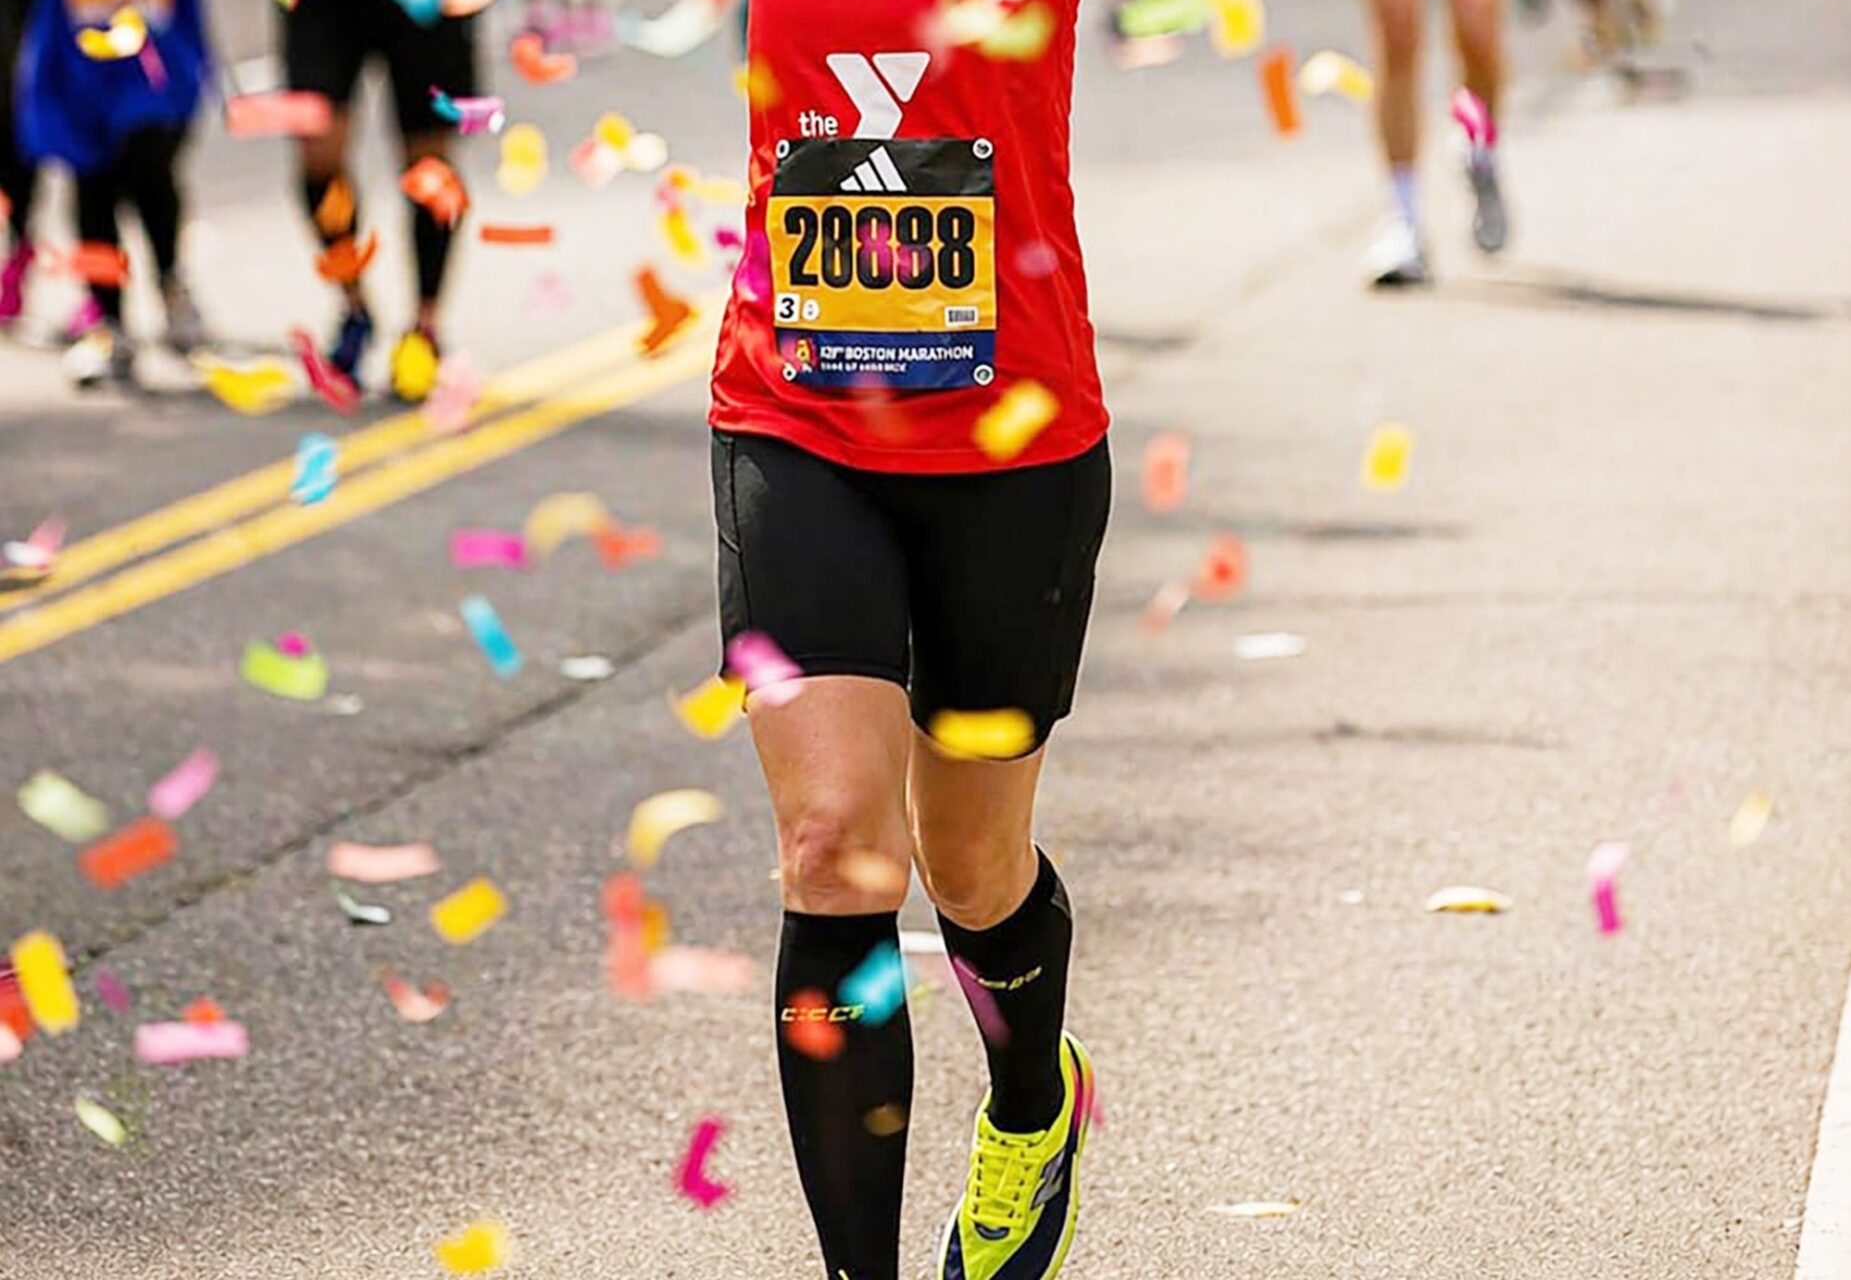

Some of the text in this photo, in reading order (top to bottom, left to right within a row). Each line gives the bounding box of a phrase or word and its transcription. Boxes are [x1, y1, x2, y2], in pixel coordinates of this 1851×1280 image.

[798, 109, 839, 137] the
[779, 296, 795, 319] 3
[845, 345, 896, 361] BOSTON
[898, 344, 974, 361] MARATHON
